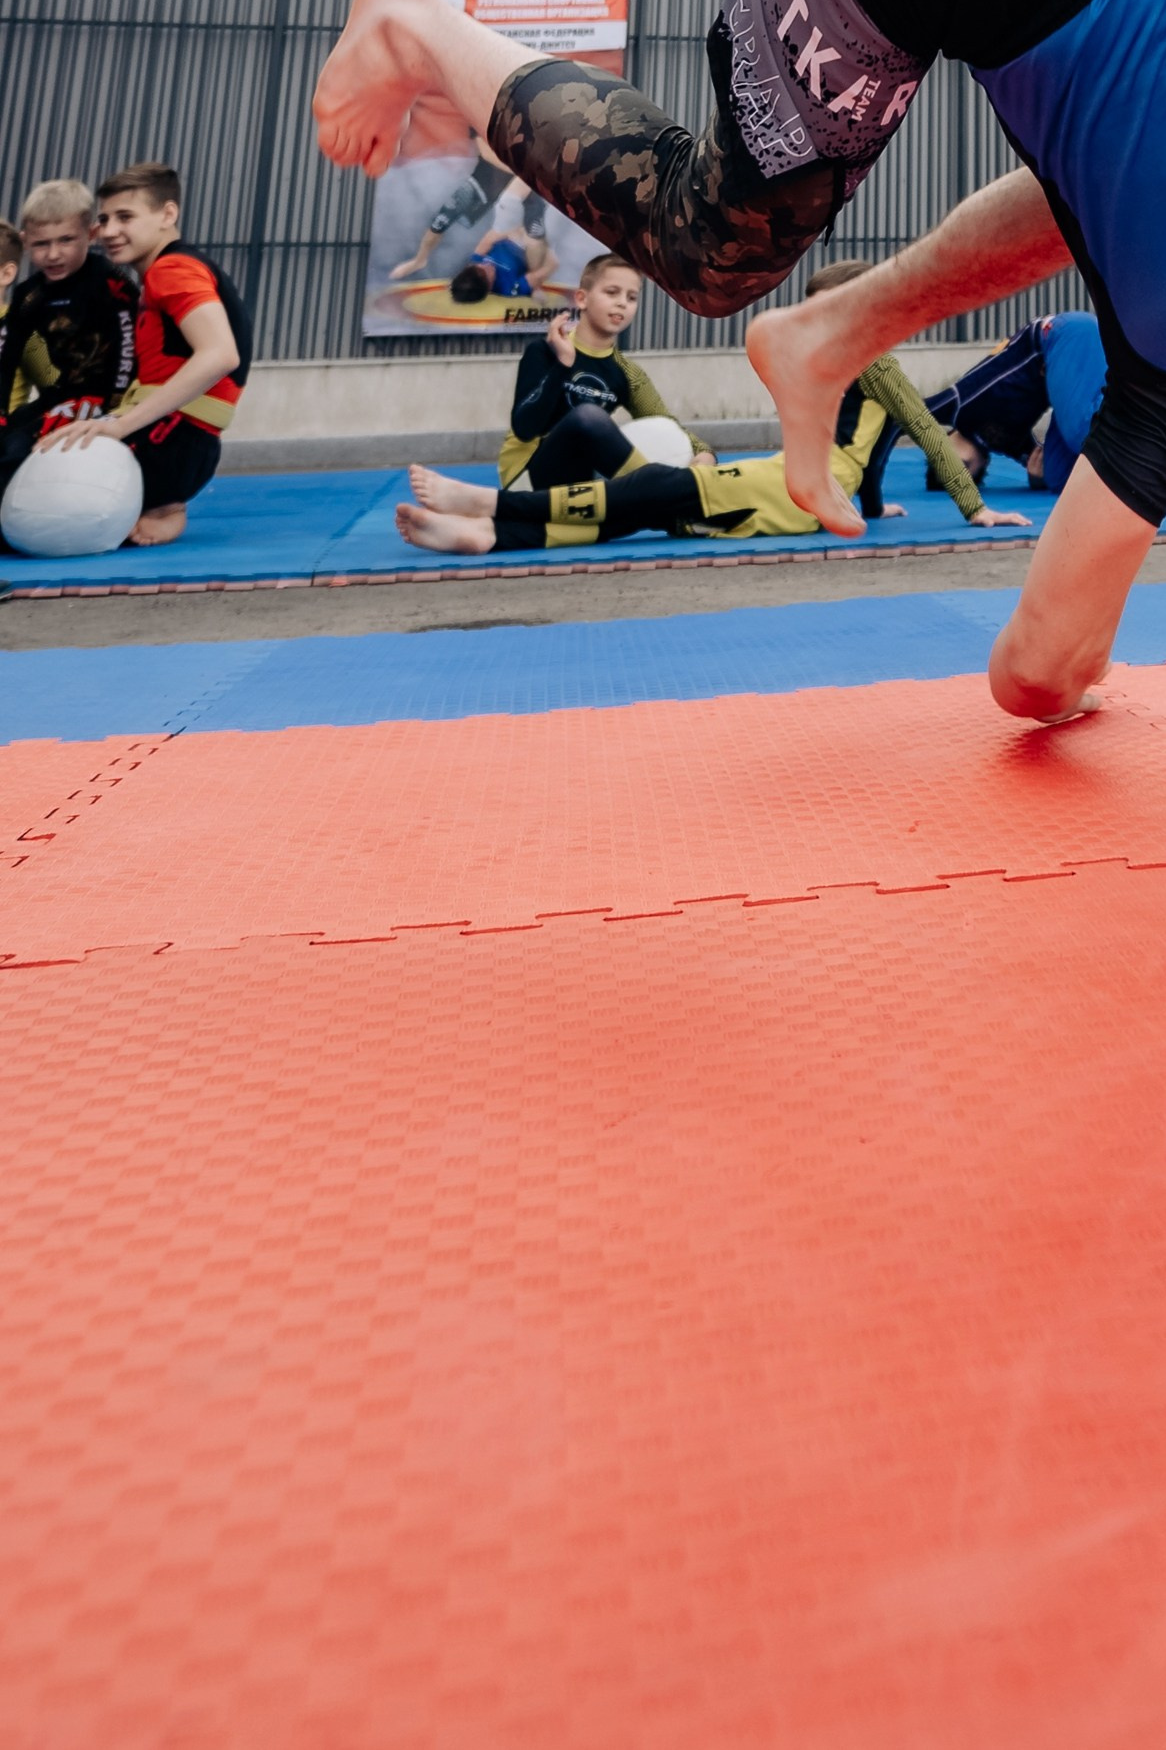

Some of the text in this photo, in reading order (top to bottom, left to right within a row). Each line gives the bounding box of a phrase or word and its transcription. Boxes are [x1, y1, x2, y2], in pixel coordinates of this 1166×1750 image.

[544, 27, 595, 37] ФЕДЕРАЦИЯ
[851, 79, 881, 122] TEAM
[115, 310, 136, 389] KIMURA
